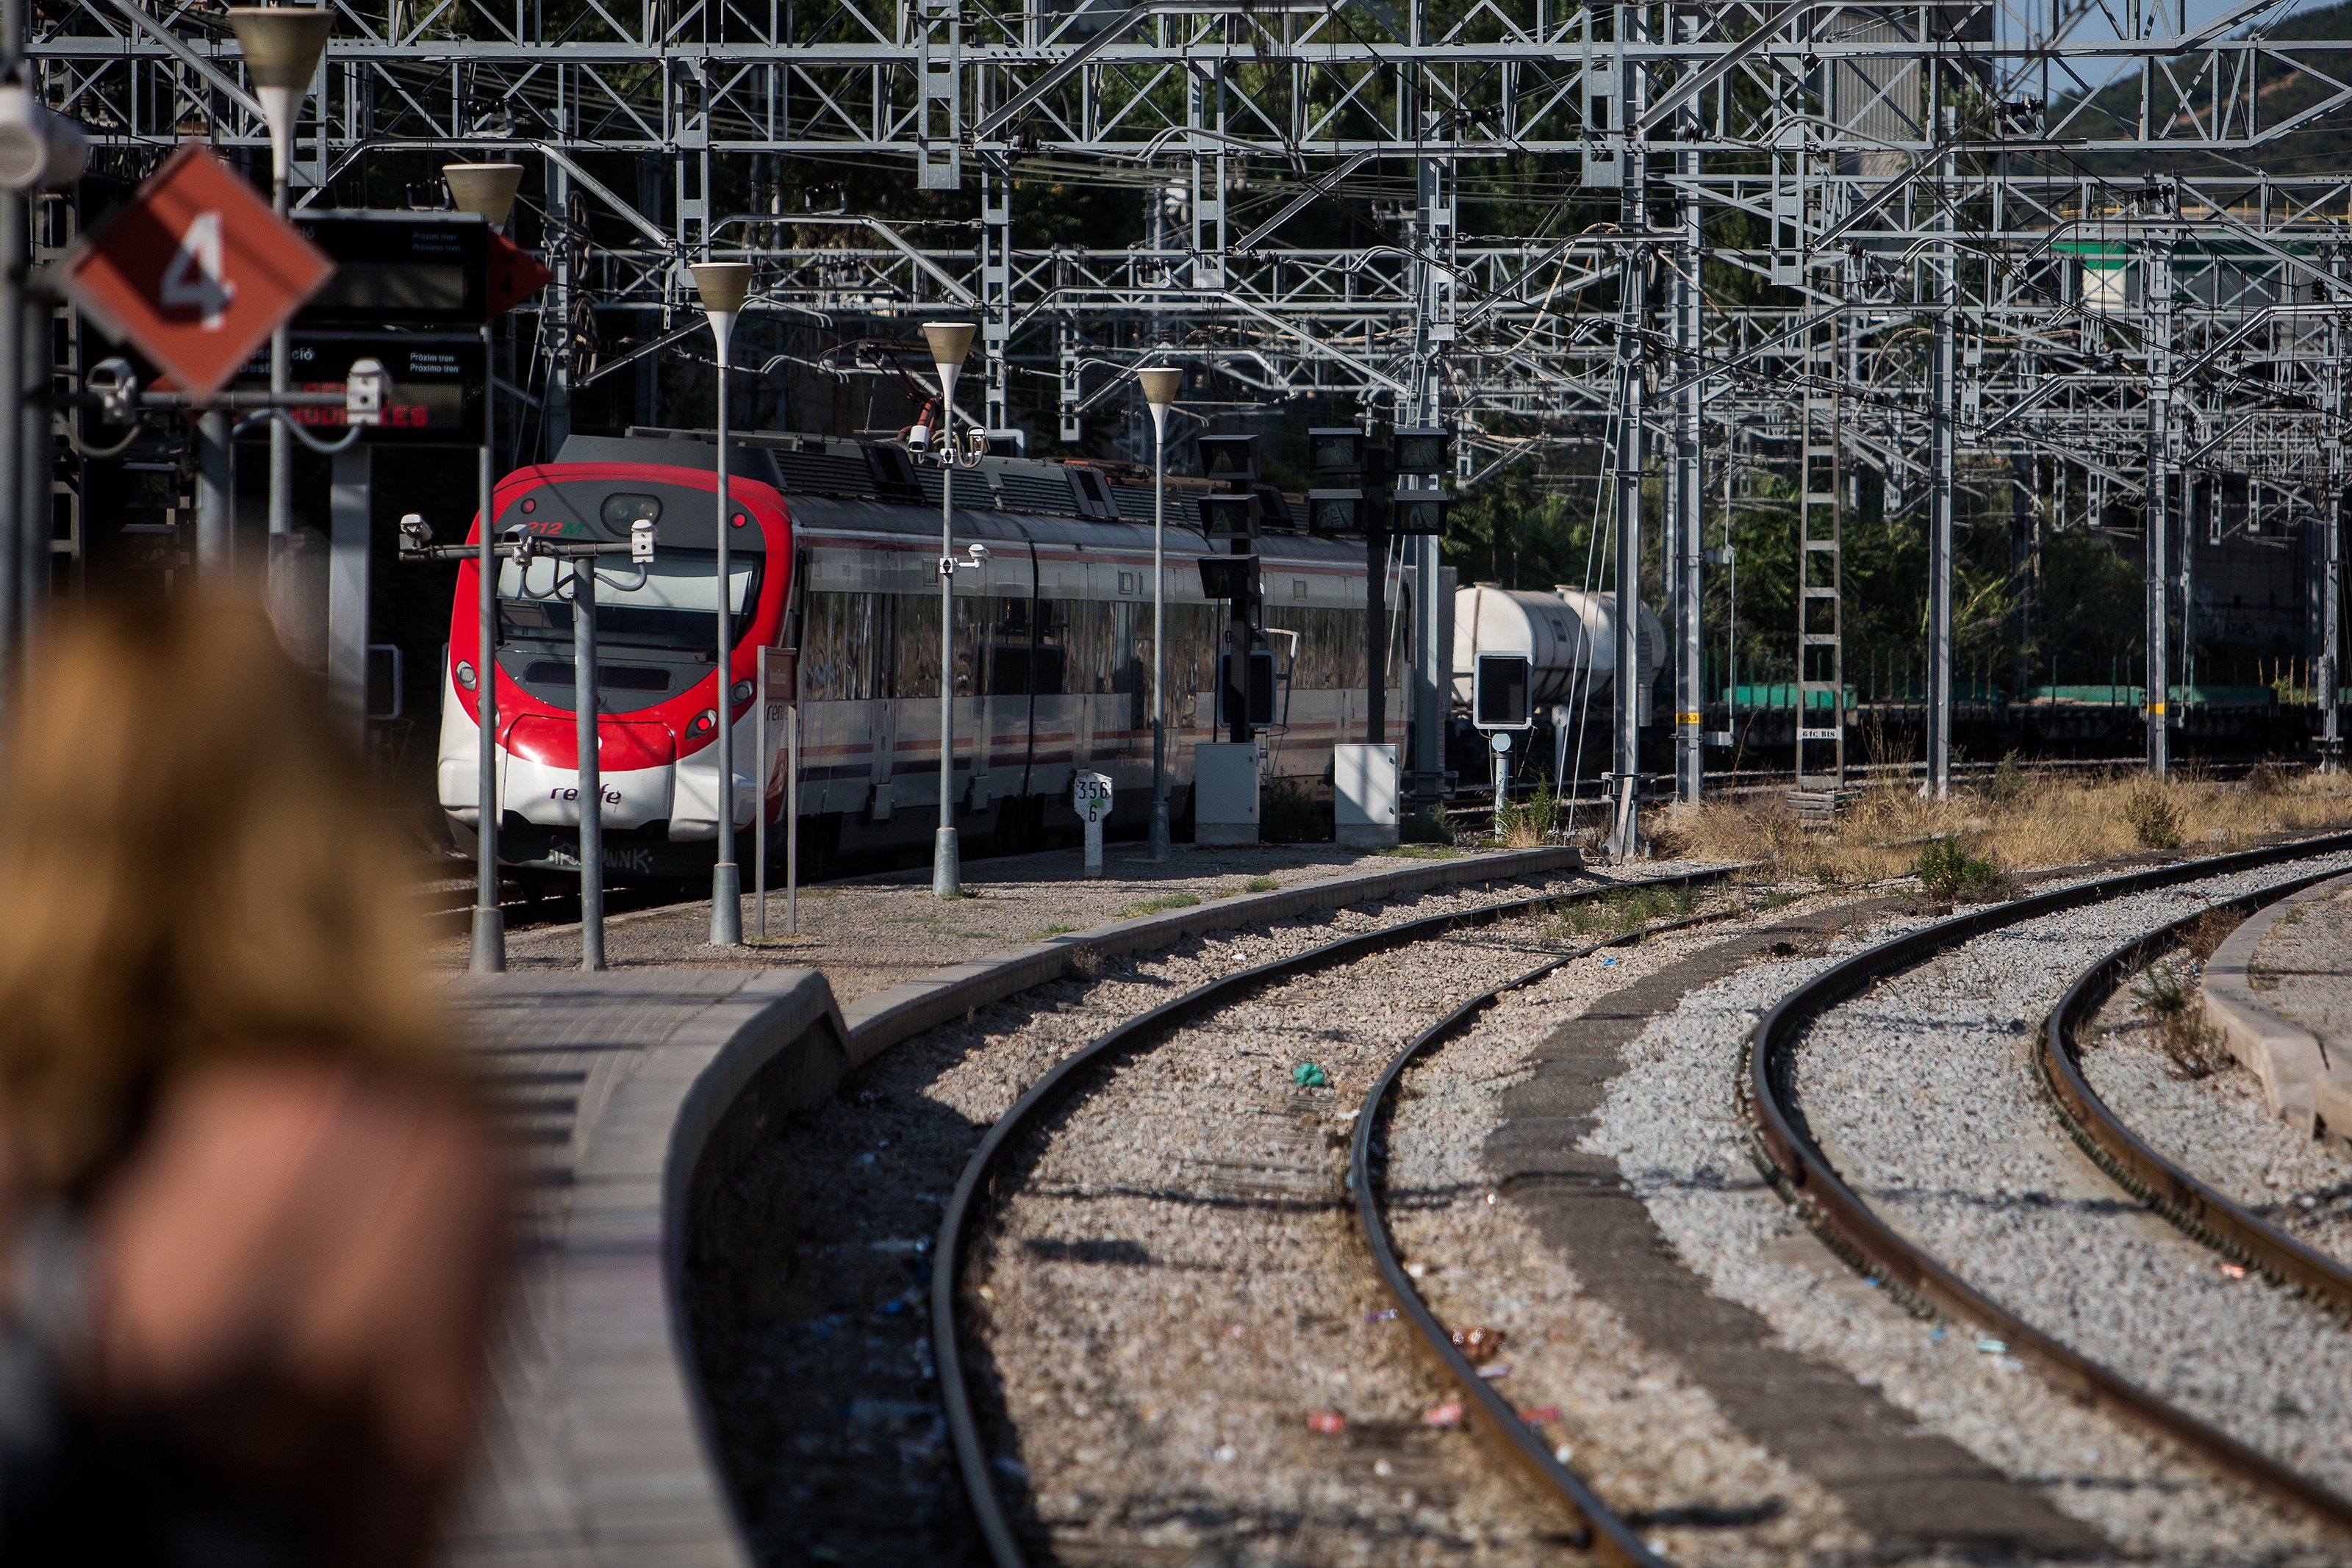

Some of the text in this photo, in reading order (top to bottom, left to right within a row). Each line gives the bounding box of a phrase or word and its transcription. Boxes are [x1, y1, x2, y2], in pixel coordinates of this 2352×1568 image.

[440, 232, 457, 242] tren
[445, 244, 462, 253] tren
[162, 211, 236, 330] 4
[438, 353, 455, 363] tren
[409, 362, 460, 374] Próximo tren
[551, 783, 622, 808] refe
[1078, 781, 1108, 799] 356
[1089, 805, 1097, 822] 6
